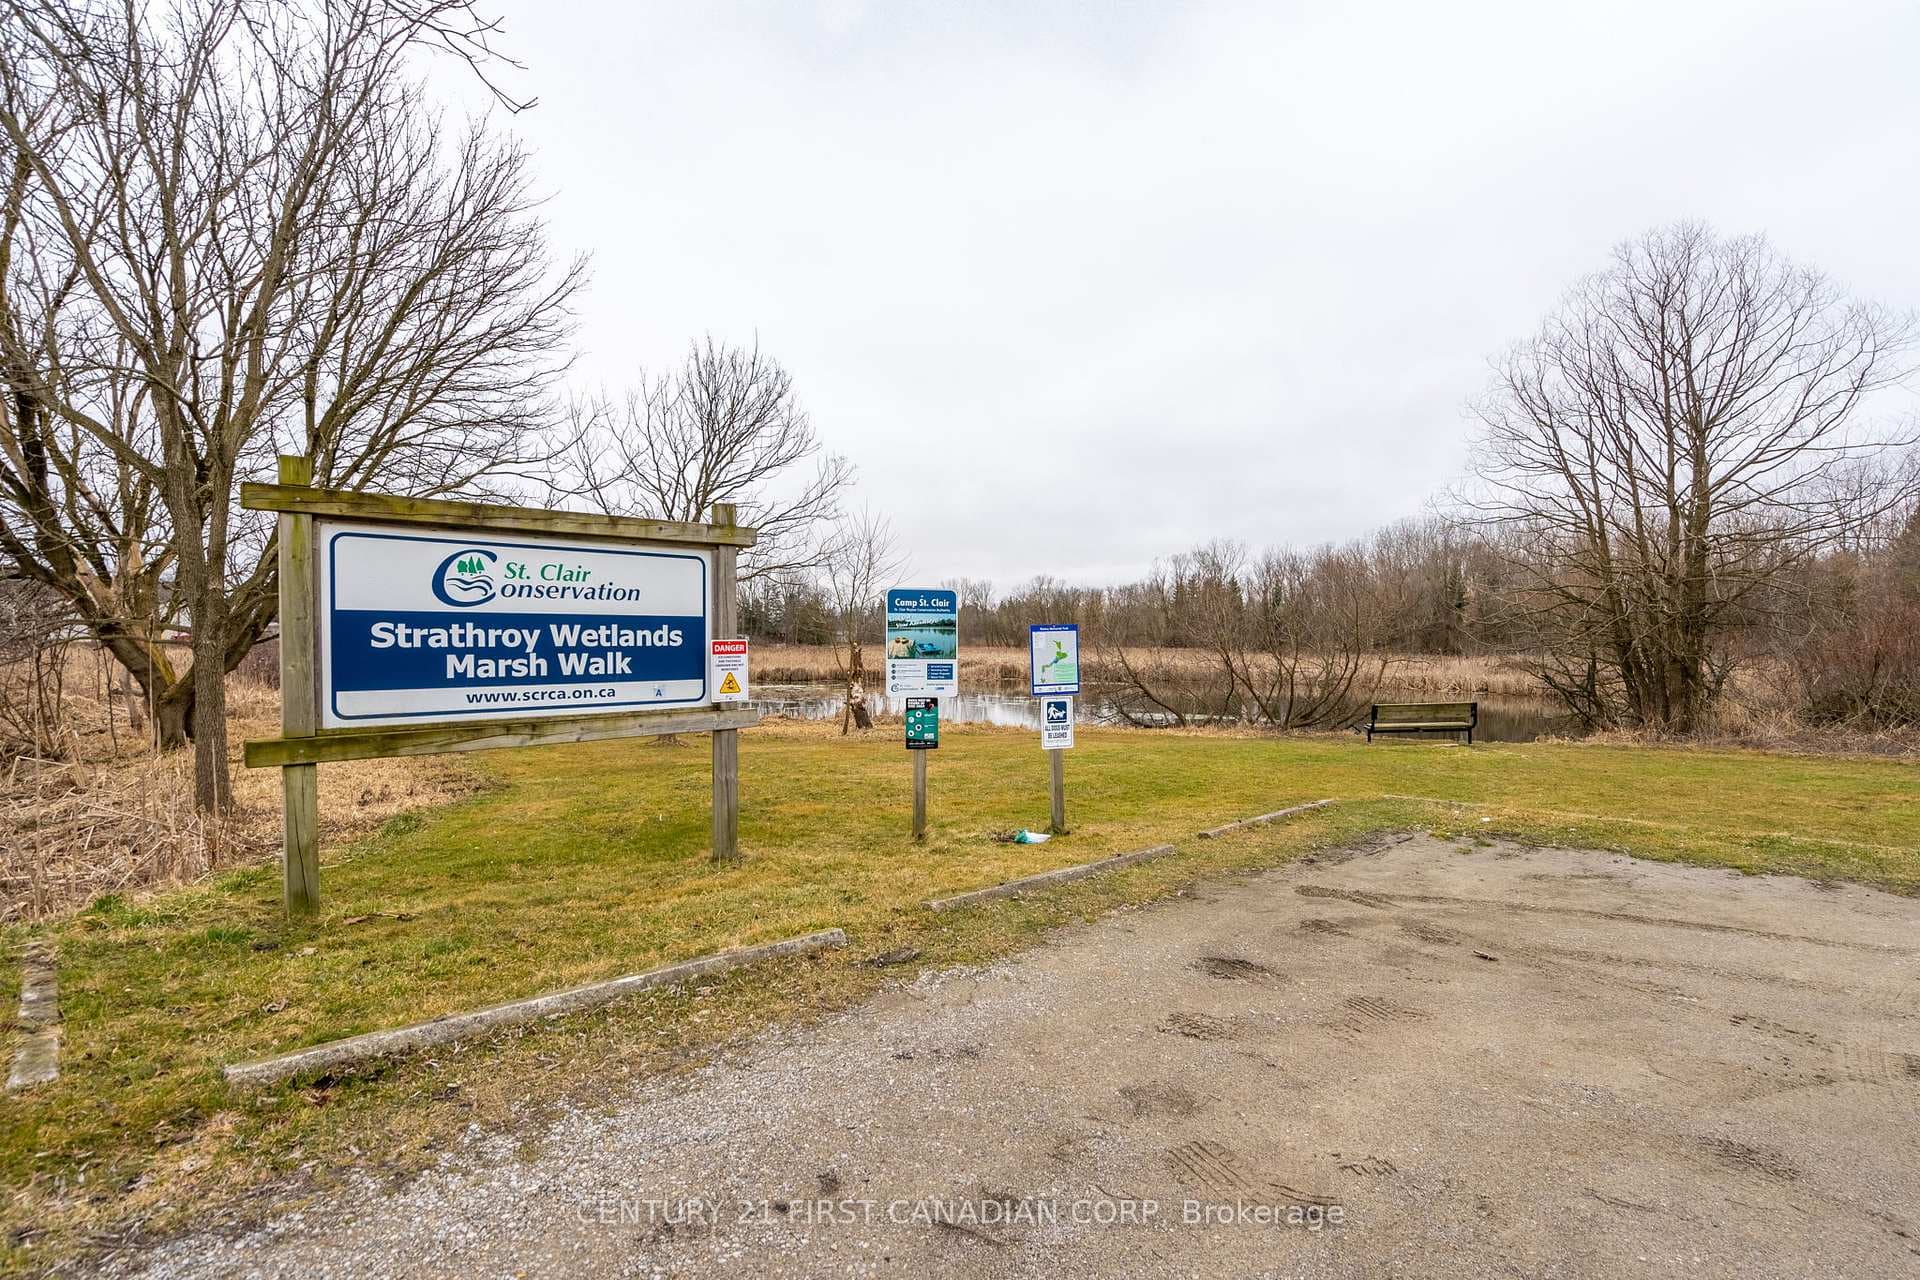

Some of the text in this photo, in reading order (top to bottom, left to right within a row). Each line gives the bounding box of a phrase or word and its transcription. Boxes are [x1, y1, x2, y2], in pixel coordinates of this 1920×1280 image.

[504, 562, 592, 583] St. Clair
[894, 597, 950, 608] Camp St. Clair
[370, 622, 684, 653] Strathroy Wetlands
[714, 644, 745, 652] DANGER
[446, 651, 633, 679] Marsh Walk
[466, 686, 616, 704] www.scrca.on.ca
